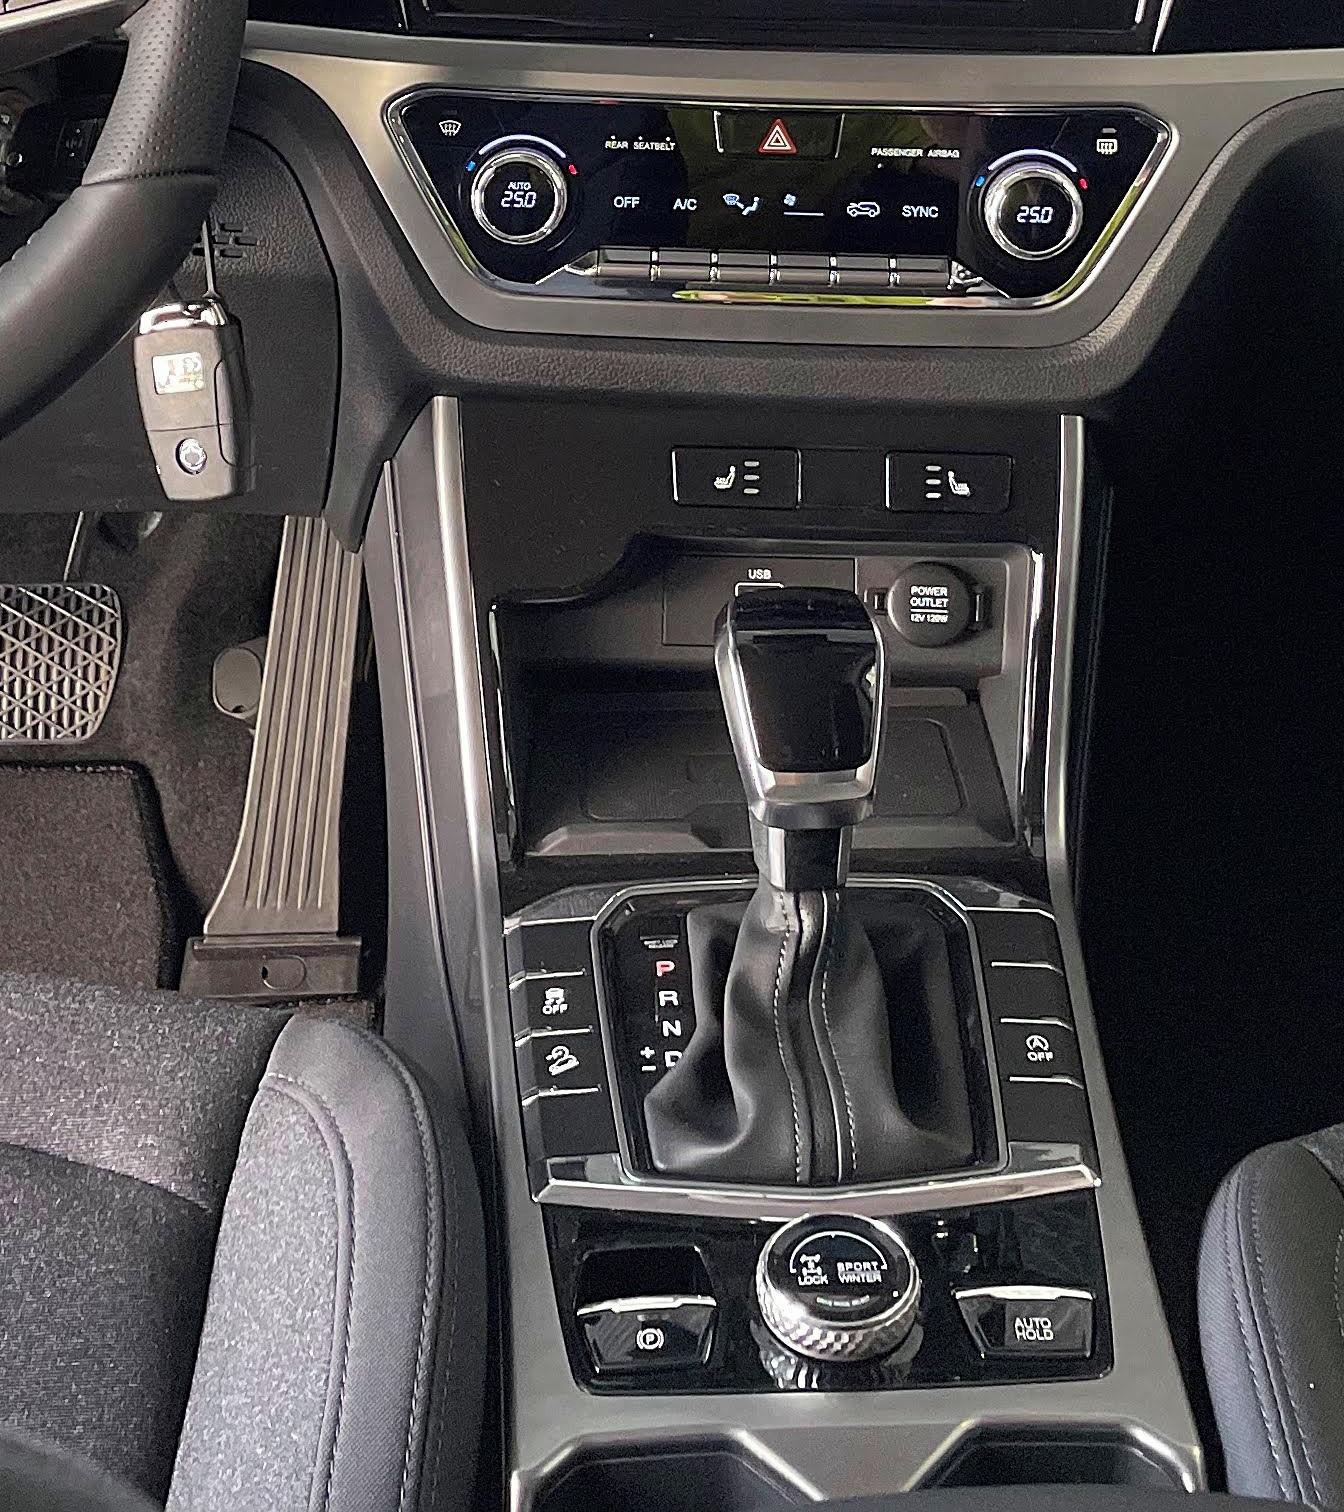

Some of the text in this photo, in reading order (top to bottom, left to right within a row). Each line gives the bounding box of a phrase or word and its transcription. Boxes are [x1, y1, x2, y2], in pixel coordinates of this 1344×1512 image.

[605, 141, 676, 151] REAR SEATBELT
[871, 148, 923, 157] PASSENGER
[508, 182, 531, 190] AUTO
[614, 196, 640, 208] OFF
[673, 198, 697, 210] A/C
[902, 206, 938, 218] SYNC
[748, 569, 772, 579] USB
[911, 586, 948, 596] POWER
[910, 597, 949, 608] OUTLET
[656, 961, 675, 976] P
[658, 991, 679, 1007] R
[542, 1004, 568, 1015] OFF
[662, 1020, 681, 1037] N
[664, 1051, 682, 1067] D
[1027, 1051, 1054, 1062] OFF
[798, 1274, 829, 1286] LOCK
[1015, 1317, 1052, 1329] AUTO
[1015, 1328, 1054, 1341] HOLD
